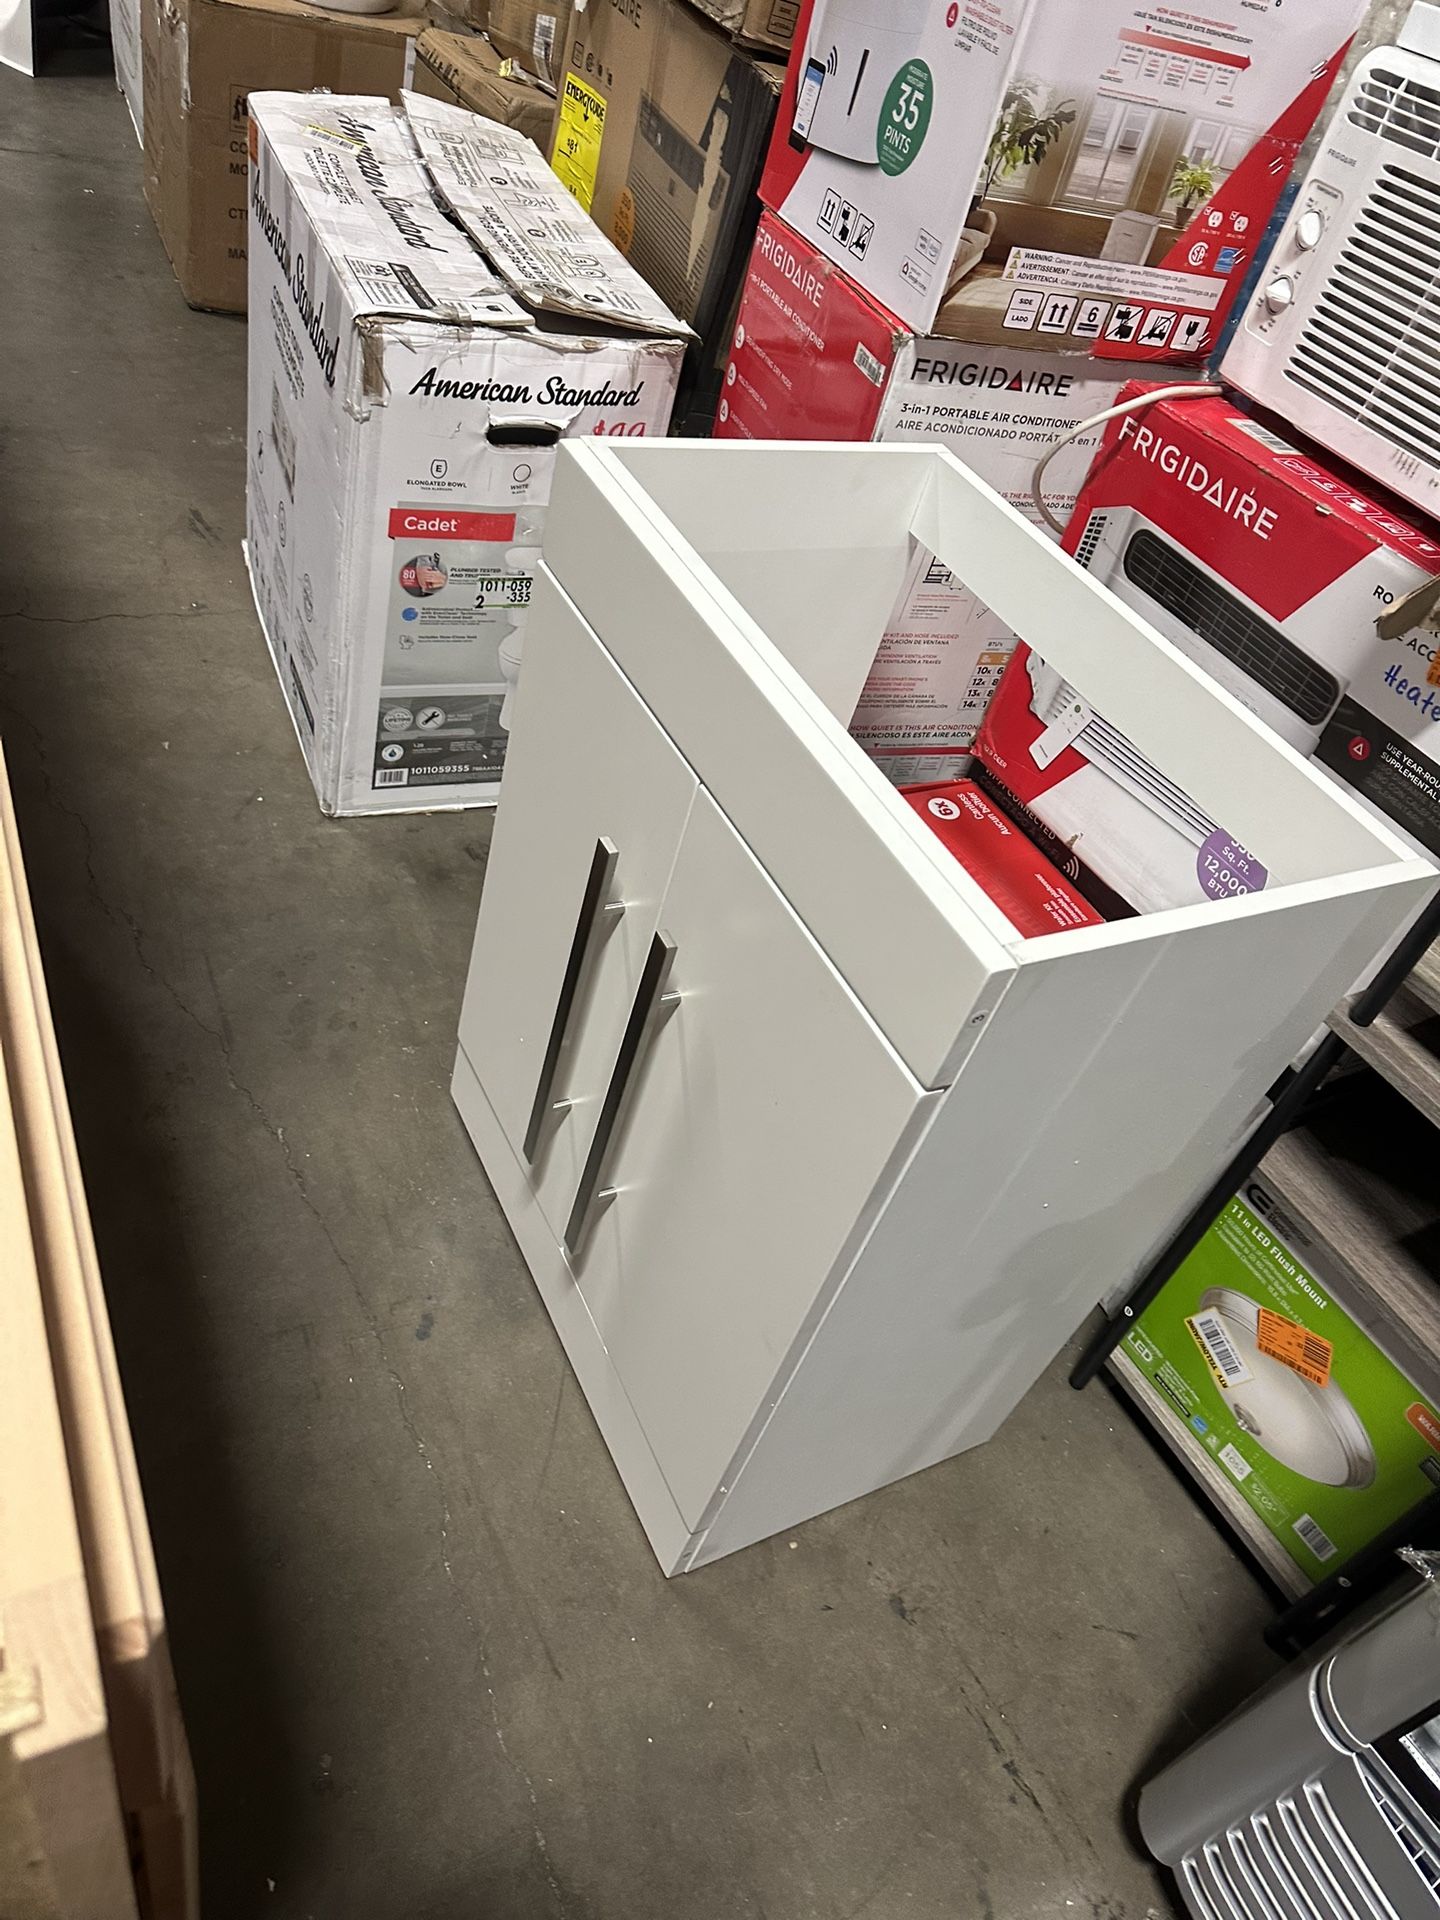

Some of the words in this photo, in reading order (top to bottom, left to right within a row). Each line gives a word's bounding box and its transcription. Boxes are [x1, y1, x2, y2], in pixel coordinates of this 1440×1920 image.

[892, 82, 925, 131] 35
[884, 125, 912, 154] PINTS
[371, 189, 449, 254] Standard
[756, 226, 825, 308] FRIGIDAIRE
[759, 278, 785, 310] PORTABLE
[783, 303, 793, 319] AIR
[792, 313, 825, 352] CONDITIONER
[1019, 298, 1034, 306] SIDE
[1087, 306, 1099, 324] 6
[291, 252, 340, 389] Standard
[1011, 314, 1029, 323] LADO
[408, 367, 533, 404] American
[536, 376, 645, 407] Standard
[910, 358, 1074, 397] FRIGIDAIRE
[901, 403, 931, 415] 3-in-1
[932, 406, 990, 421] PORTABLE
[991, 413, 1010, 423] AIR
[896, 420, 923, 431] AIRE
[924, 422, 1017, 439] ACONDICIONADO
[1019, 429, 1061, 444] PORTÁT
[1077, 438, 1090, 446] en
[1091, 437, 1097, 446] 1
[406, 479, 446, 487] ELONGATED
[1118, 415, 1280, 541] FRIGIDAIRE
[404, 516, 458, 532] Cadet
[480, 581, 532, 592] 1011-059
[507, 592, 531, 603] -355
[475, 595, 485, 609] 2
[410, 765, 470, 775] 1011059355
[1381, 752, 1437, 800] SUPPLEMENTAL
[1386, 742, 1402, 757] USE
[1402, 752, 1440, 789] YEAR-ROU
[936, 800, 954, 816] 6x
[957, 793, 984, 820] Canless
[989, 813, 1013, 836] Aucun
[1222, 846, 1236, 863] Sq.
[1237, 859, 1249, 875] Ft.
[1204, 854, 1248, 896] 12,000
[1207, 878, 1229, 898] BTU
[1231, 1204, 1244, 1218] 11
[1251, 1226, 1271, 1247] LED
[1269, 1247, 1296, 1276] Flush
[1295, 1273, 1328, 1310] Mount
[1127, 1332, 1152, 1362] LED
[1216, 1372, 1229, 1389] RTV
